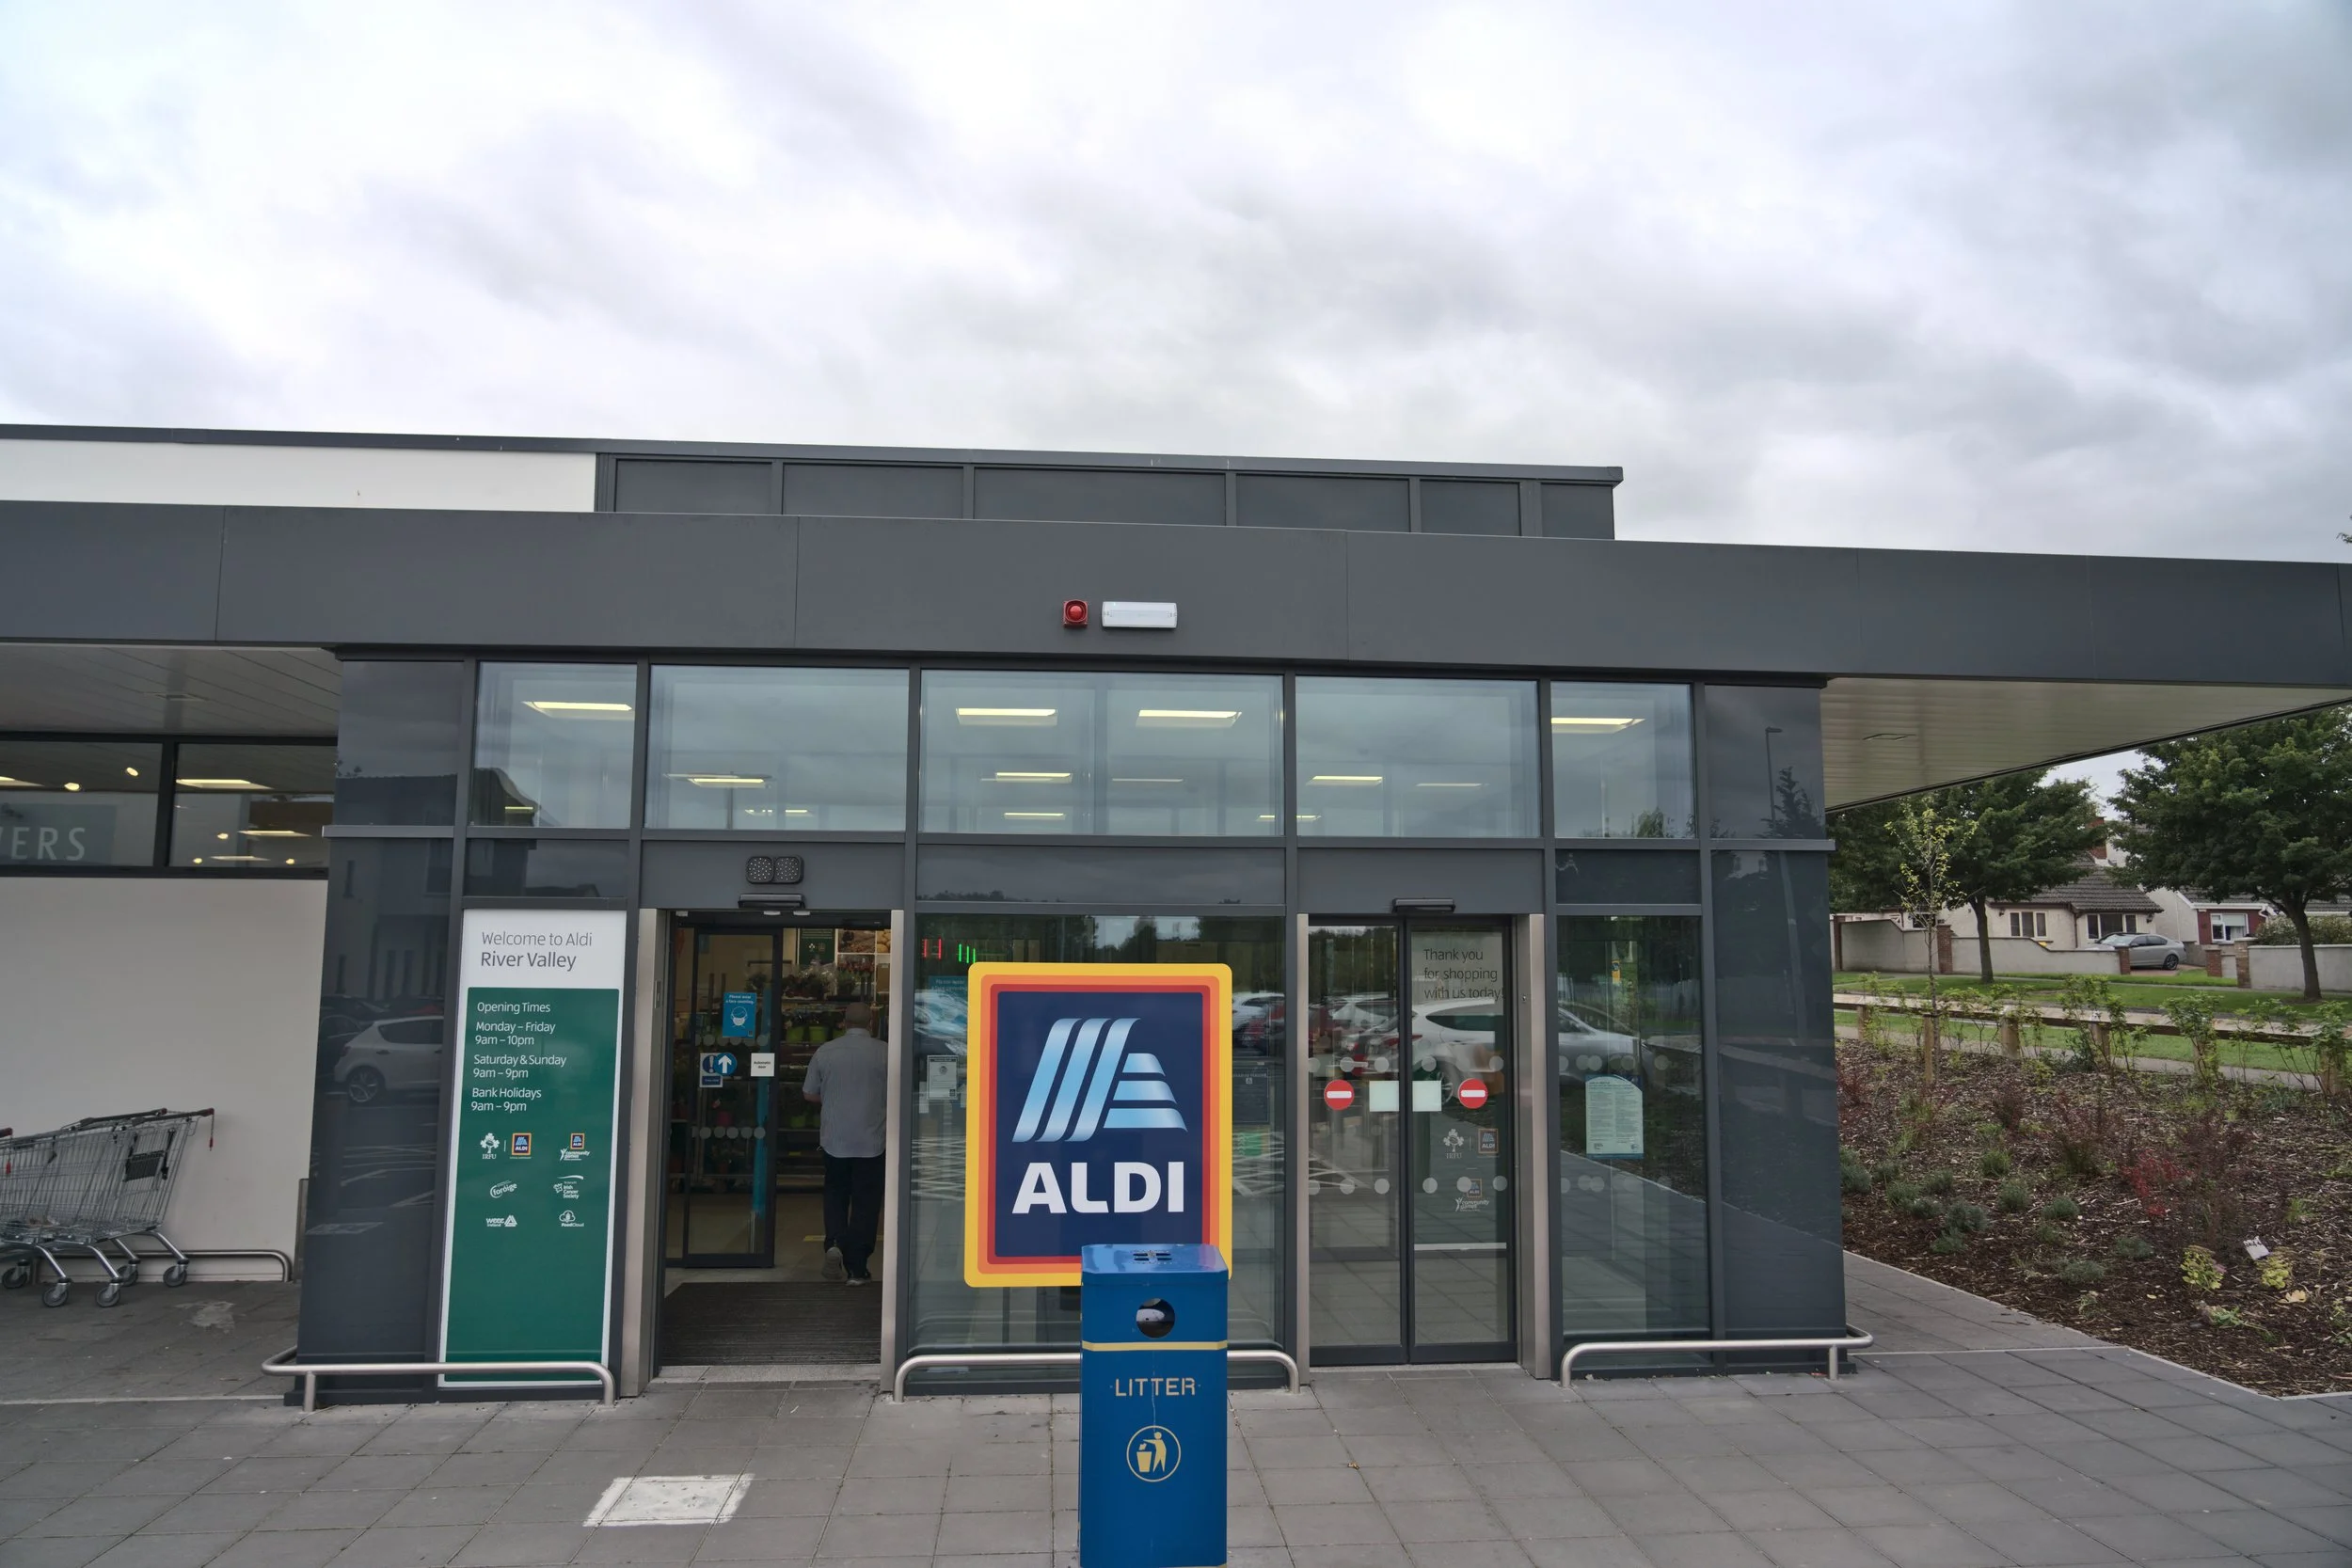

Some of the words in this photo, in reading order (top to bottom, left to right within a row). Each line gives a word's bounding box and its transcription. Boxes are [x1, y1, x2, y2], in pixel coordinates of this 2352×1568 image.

[0, 826, 87, 862] ERS
[481, 931, 547, 946] Welcome
[548, 932, 563, 946] to
[565, 932, 593, 947] Aldi
[481, 951, 524, 967] River
[527, 952, 577, 972] Valley
[1423, 948, 1459, 960] Thank
[1461, 951, 1484, 963] you
[1423, 967, 1441, 979] for
[1443, 967, 1498, 982] shopping
[1423, 986, 1450, 999] with
[1452, 989, 1465, 998] us
[477, 1002, 520, 1014] Opening
[522, 1002, 551, 1013] Times
[476, 1022, 516, 1034] Monday
[525, 1022, 556, 1034] Friday
[474, 1036, 498, 1045] 9am
[507, 1036, 534, 1047] 10pm
[473, 1054, 518, 1066] Saturday
[519, 1055, 528, 1065] &
[529, 1054, 566, 1067] Sunday
[473, 1069, 496, 1078] 9am
[505, 1069, 529, 1080] 9pm
[471, 1087, 498, 1098] Bank
[499, 1087, 542, 1100] Holidays
[470, 1101, 494, 1111] 9am
[503, 1101, 527, 1113] 9pm
[1011, 1161, 1184, 1214] ALDI
[1115, 1377, 1196, 1397] LITTER
